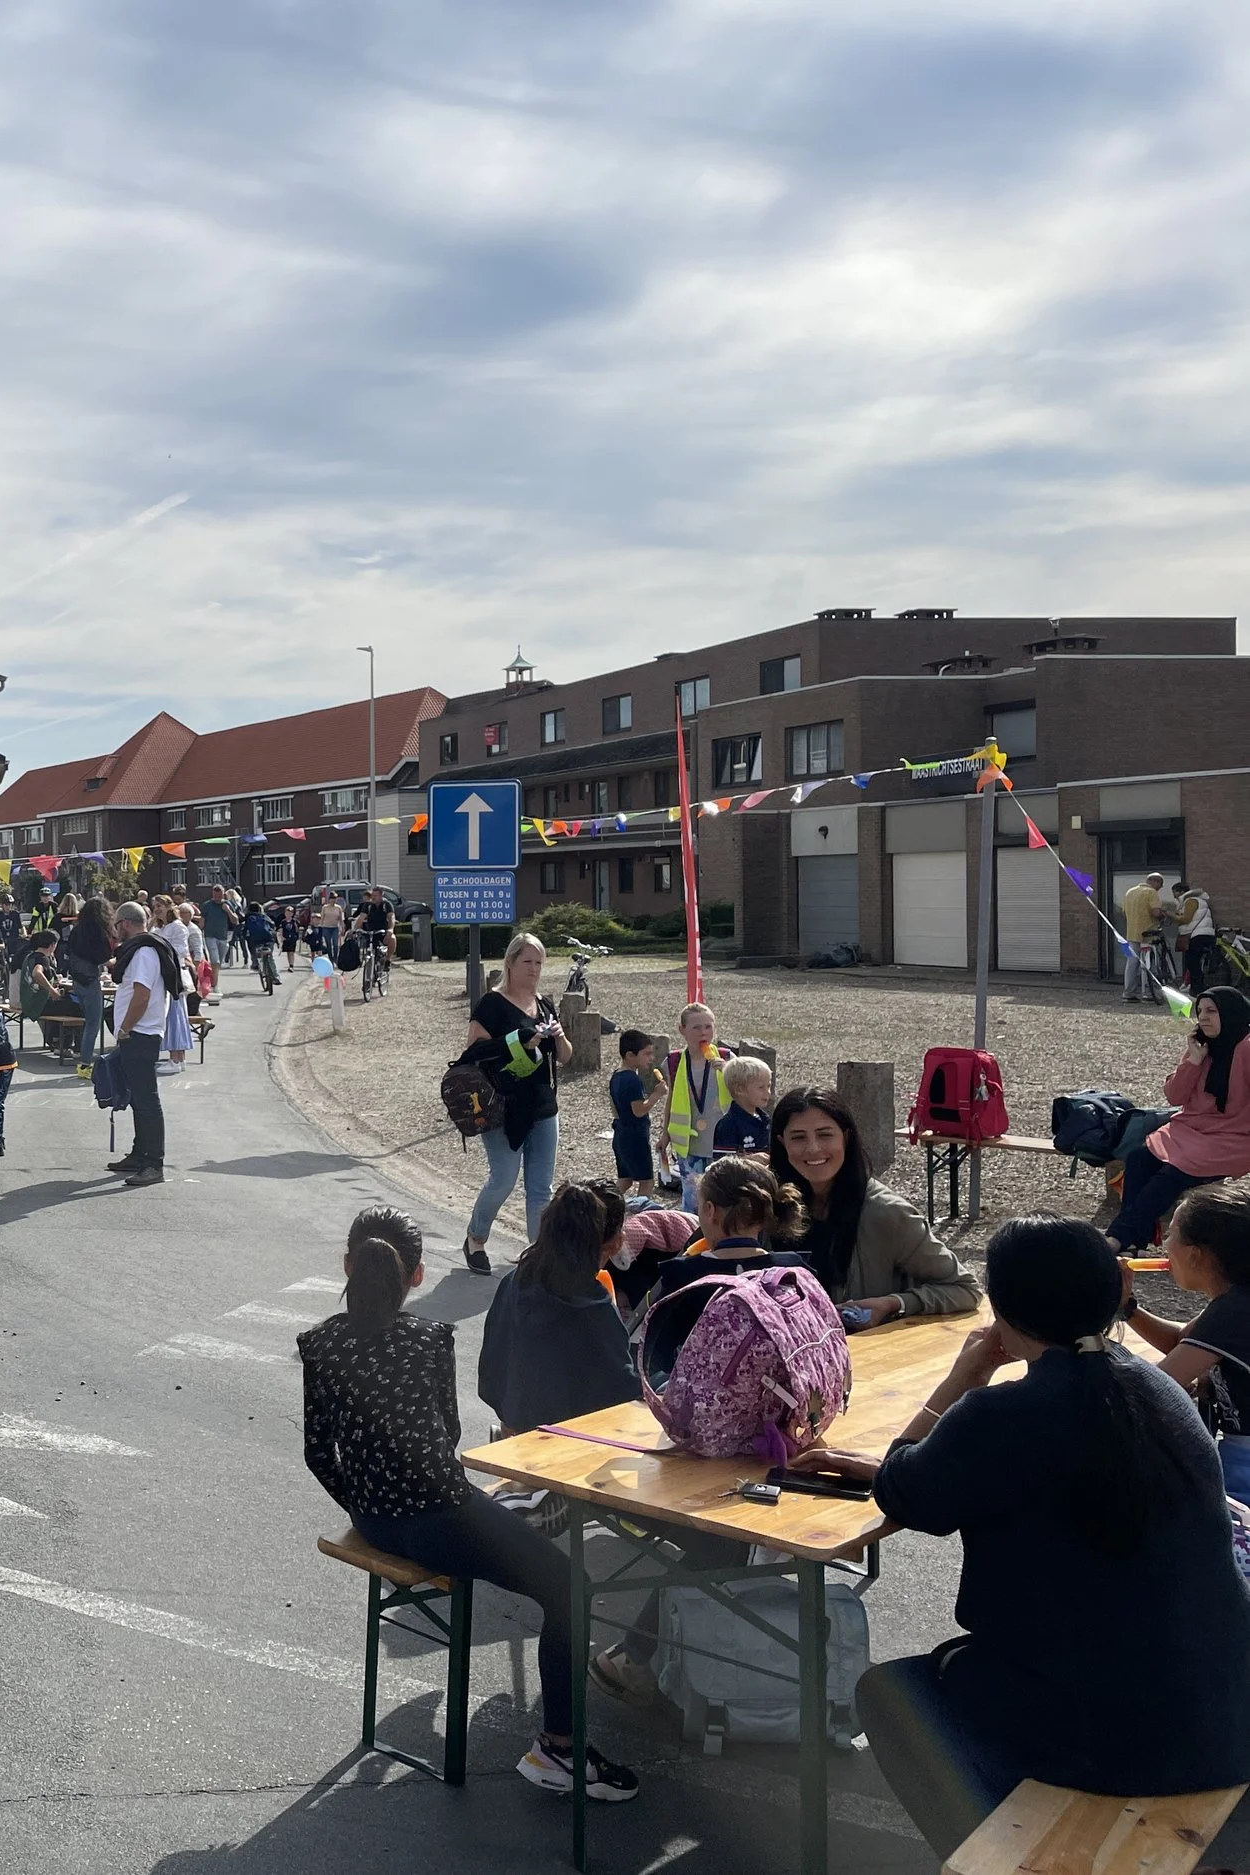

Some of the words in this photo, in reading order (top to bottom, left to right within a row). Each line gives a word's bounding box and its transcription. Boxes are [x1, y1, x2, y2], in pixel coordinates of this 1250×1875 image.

[438, 877, 449, 885] OP
[453, 877, 511, 885] SCHOOLDAGEN
[438, 890, 469, 898] TUSSEN
[483, 890, 494, 898] EN
[499, 890, 504, 898] 9
[439, 901, 462, 909] 12.00
[465, 901, 477, 909] EN
[480, 901, 503, 909] 13.00
[439, 912, 462, 920] 15.00
[465, 912, 477, 920] EN
